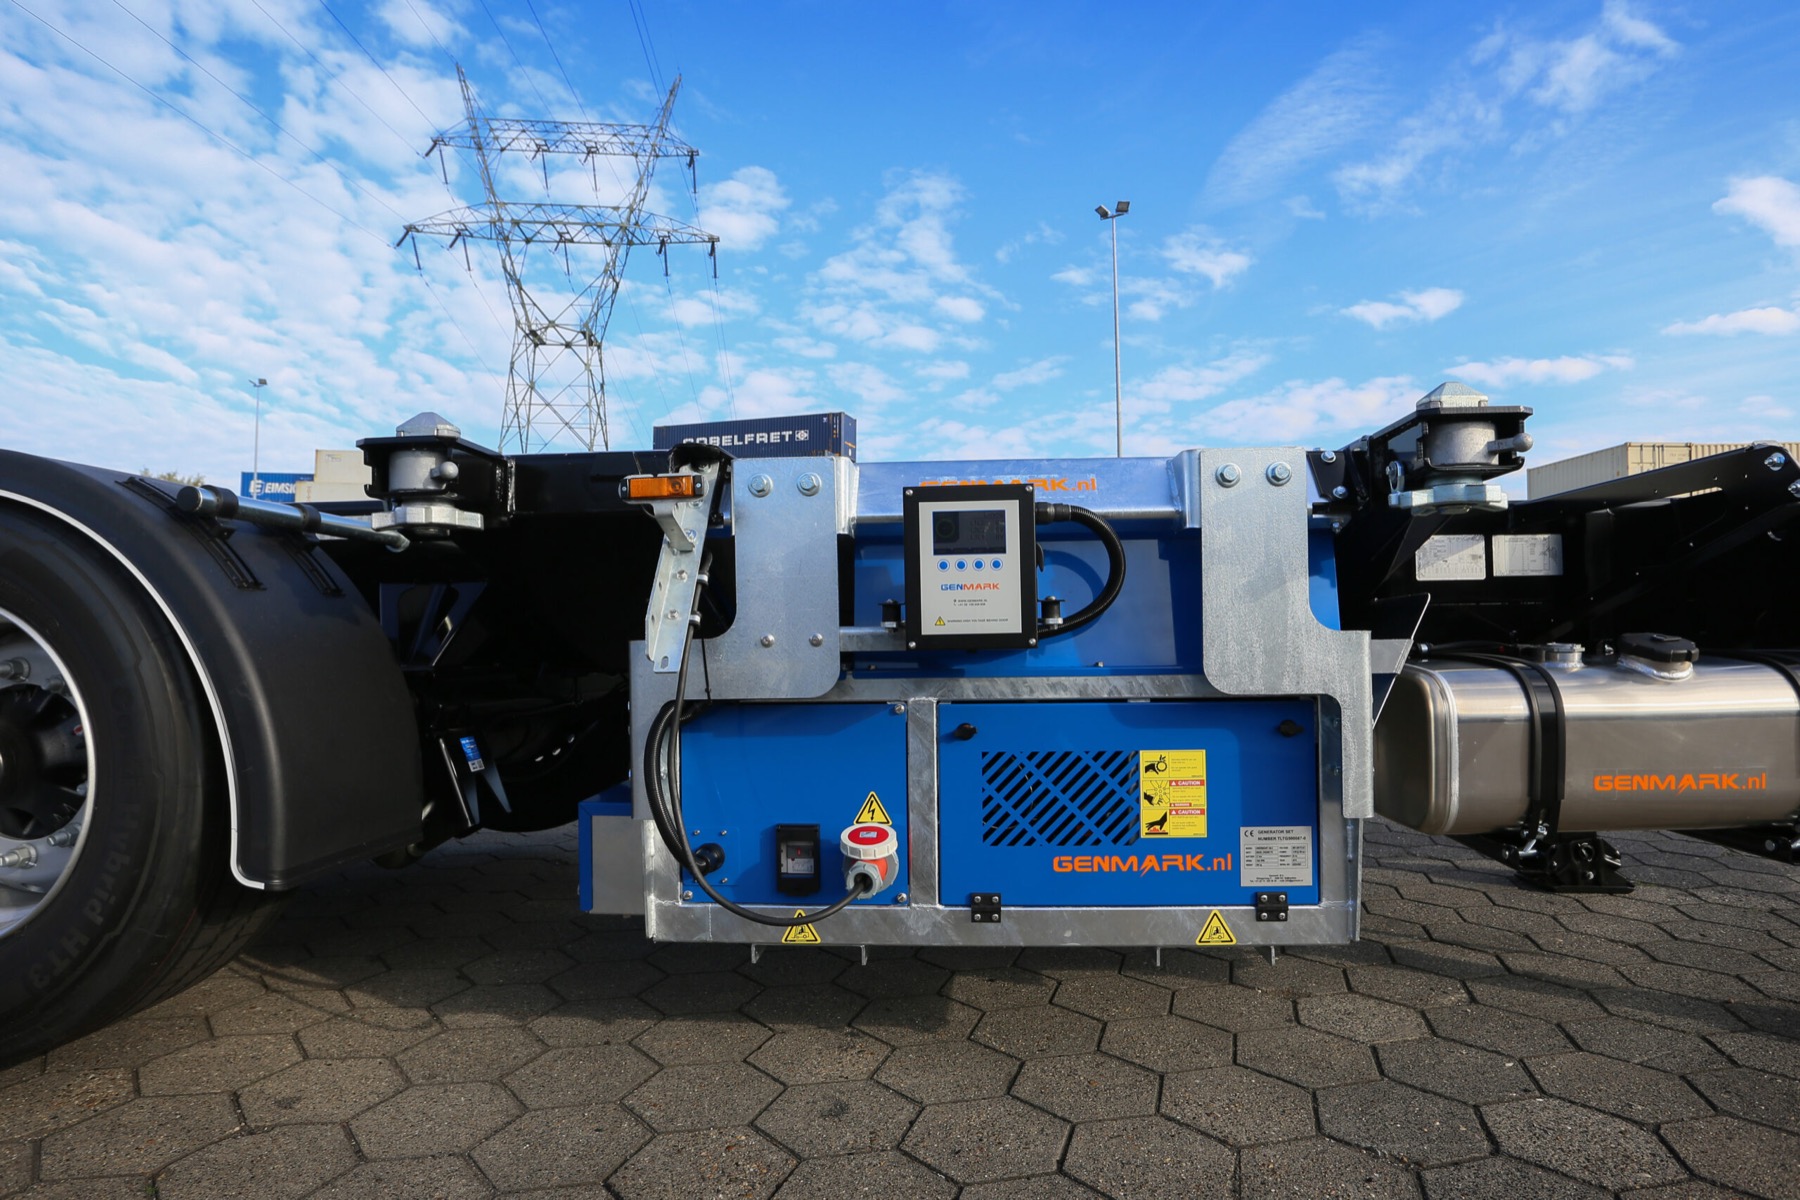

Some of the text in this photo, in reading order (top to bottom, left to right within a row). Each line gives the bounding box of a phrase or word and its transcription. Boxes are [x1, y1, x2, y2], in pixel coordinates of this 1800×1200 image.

[941, 583, 999, 591] GENMARK
[1594, 772, 1766, 796] GENMARK.nl
[1053, 853, 1232, 877] GENMARK.nl
[29, 926, 90, 989] HT3
